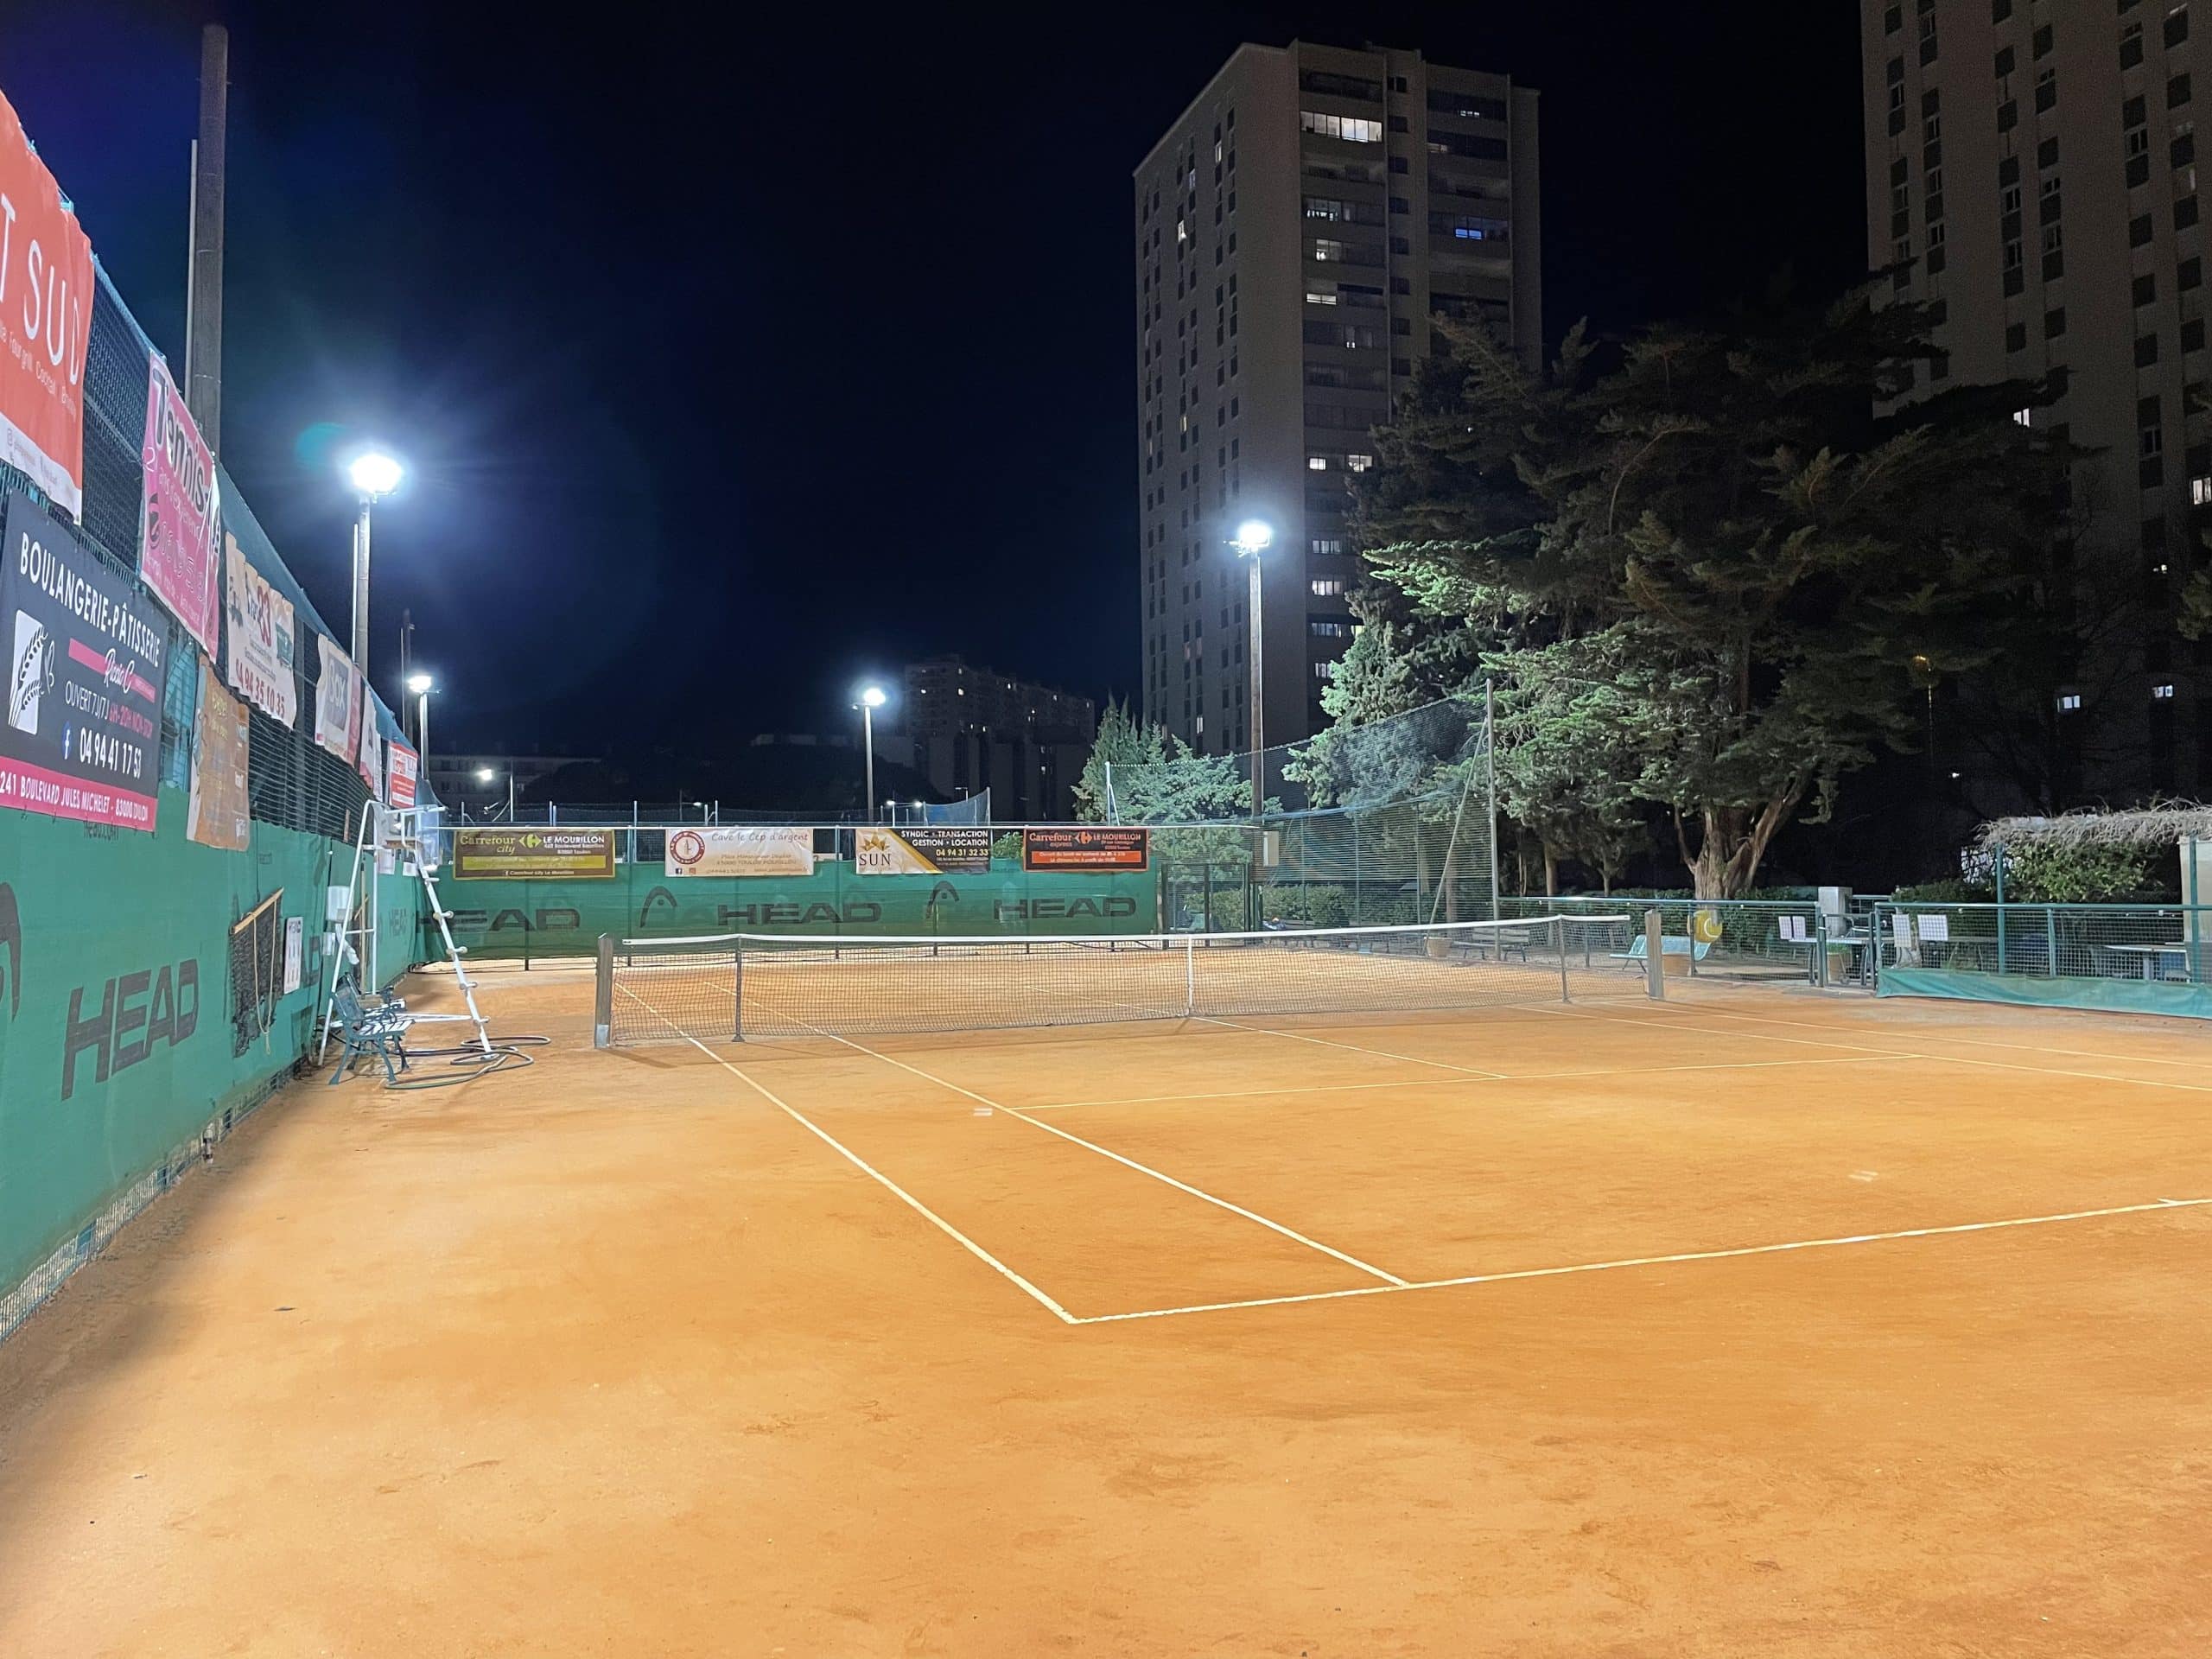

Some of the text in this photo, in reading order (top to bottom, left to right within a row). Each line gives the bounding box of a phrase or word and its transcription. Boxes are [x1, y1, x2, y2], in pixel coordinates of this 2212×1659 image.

[65, 680, 92, 713] OUVERT
[79, 727, 142, 779] 04 94 41 17 53
[0, 771, 16, 796] 241
[20, 775, 60, 805] BOULEVARD
[60, 786, 80, 810] JULES
[80, 791, 111, 815] MICHELET
[460, 835, 516, 845] Carrefour
[711, 832, 809, 843] Cave le Cep d'argent
[1029, 832, 1072, 842] Carrefour
[496, 845, 516, 855] city
[859, 853, 892, 866] SUN
[936, 849, 945, 857] 04
[957, 849, 967, 857] 31
[969, 849, 978, 857] 32
[979, 849, 989, 857] 33
[717, 902, 882, 926] HEAD
[994, 897, 1137, 920] HEAD
[416, 908, 581, 933] HEAD
[61, 958, 200, 1102] HEAD
